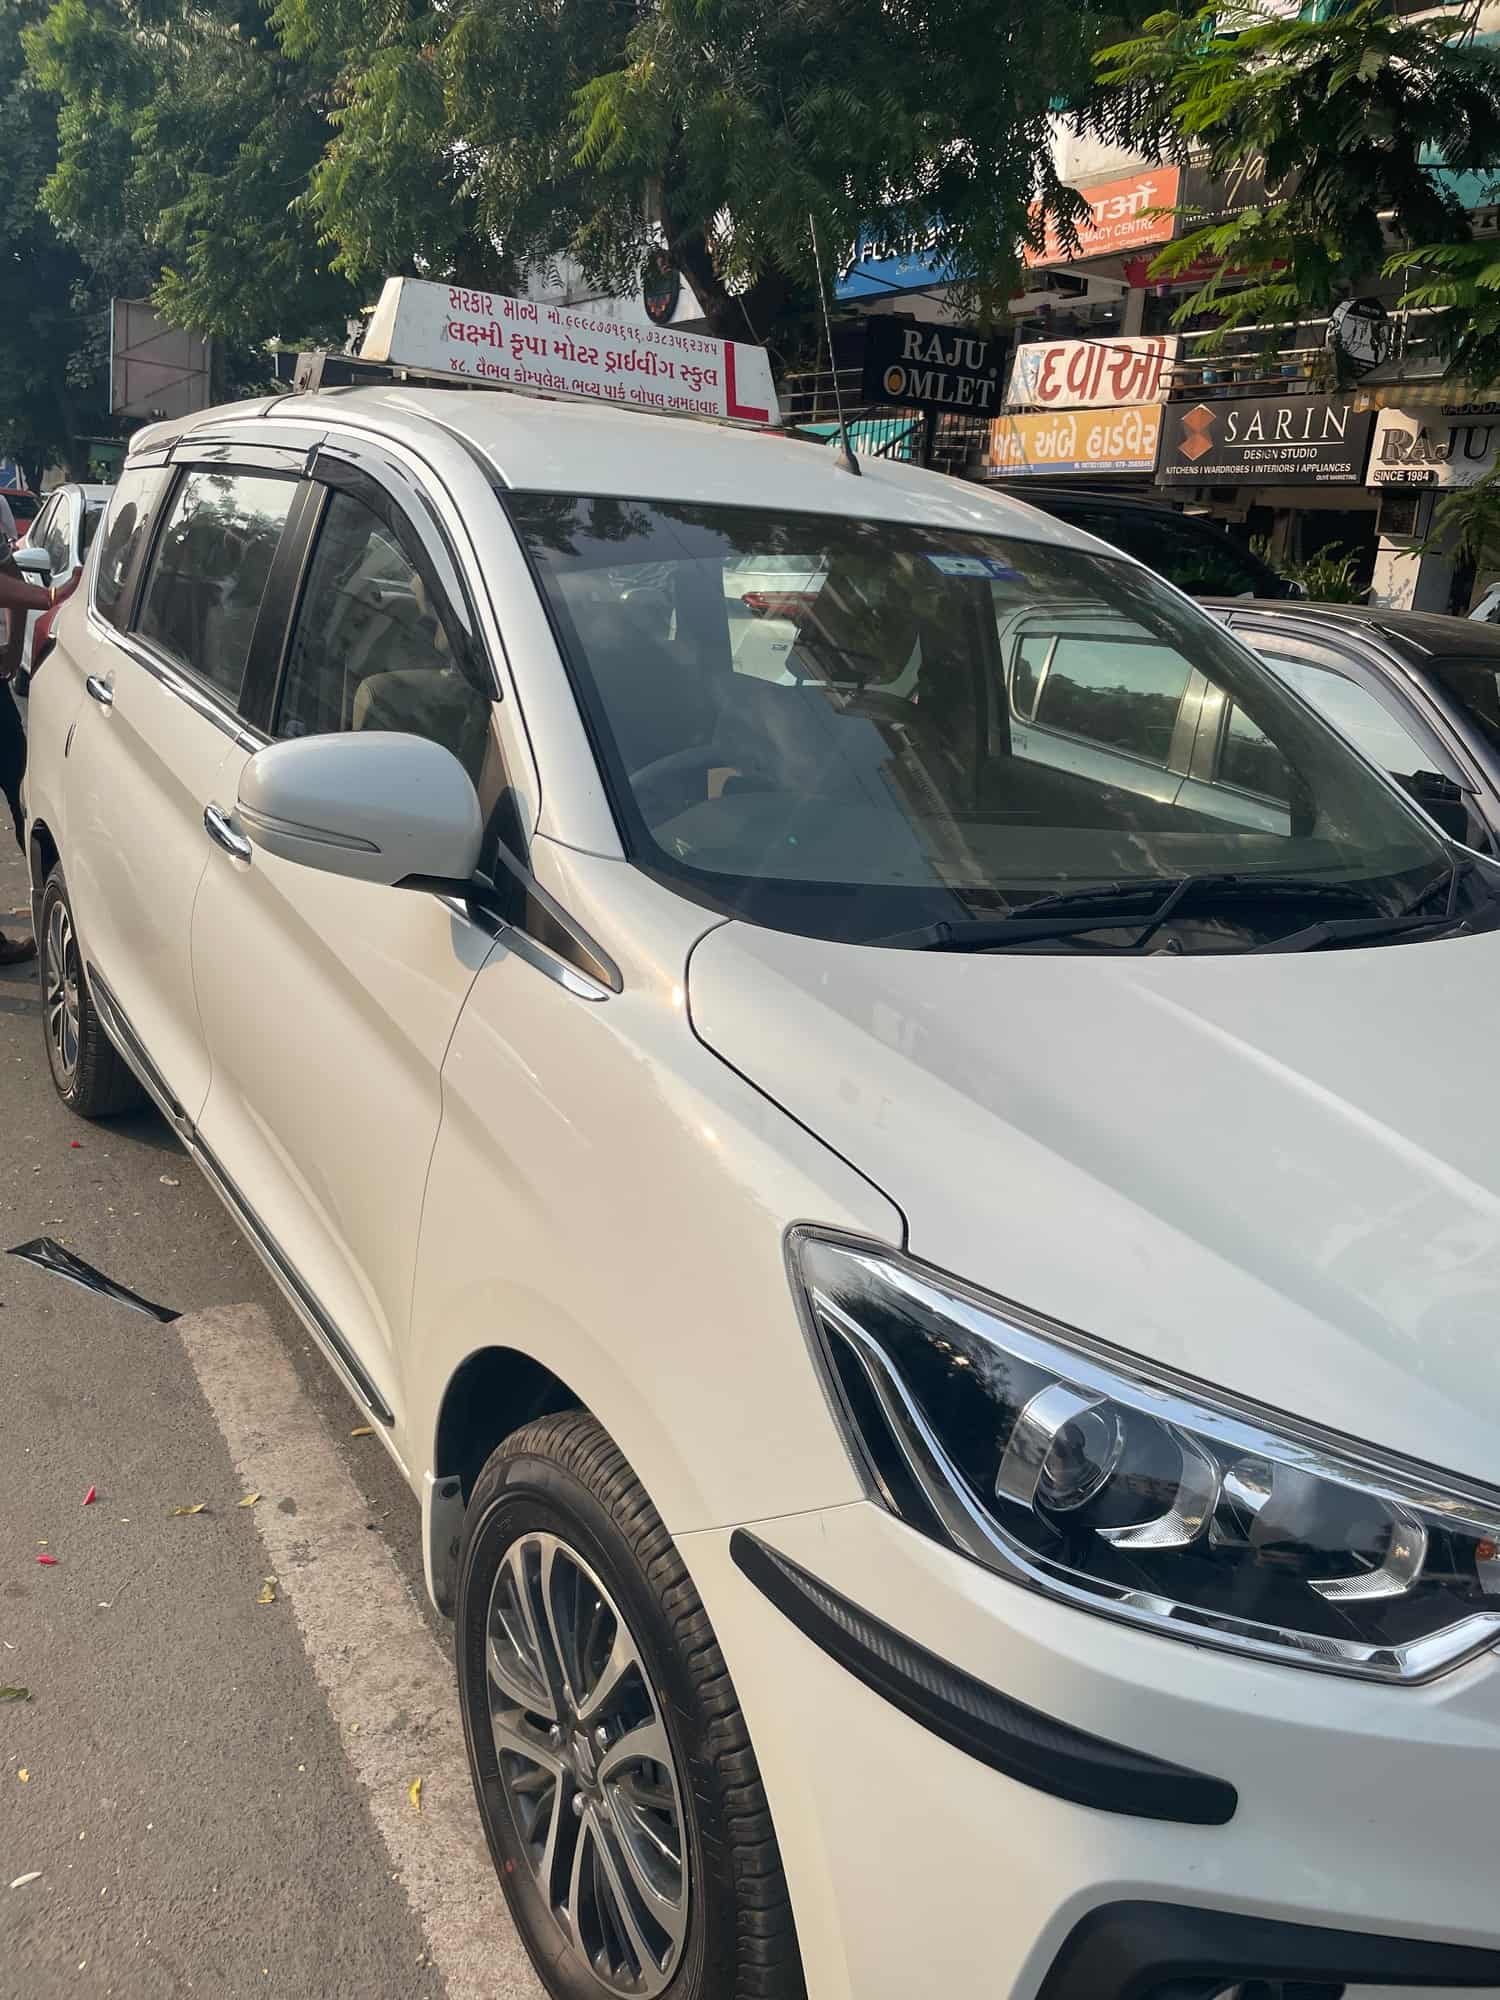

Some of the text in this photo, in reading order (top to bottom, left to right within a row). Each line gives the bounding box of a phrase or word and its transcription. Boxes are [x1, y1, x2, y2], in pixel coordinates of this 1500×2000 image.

[448, 287, 494, 316] સરકાર
[503, 298, 539, 325] માન્ય
[448, 321, 504, 348] લક્ષ્મી
[510, 333, 548, 360] કૃપા
[553, 334, 599, 366] મોટર
[901, 329, 988, 370] RAJU
[476, 356, 510, 380] વૈભવ
[571, 379, 601, 396] ભવ્ય
[604, 381, 626, 399] પાર્ક
[630, 385, 664, 406] બોપલ
[667, 395, 720, 415] અમદાવાદ
[724, 341, 769, 423] L
[883, 365, 996, 408] OMLET
[1037, 336, 1167, 401] દવાઓ
[1224, 405, 1351, 442] SARIN
[1243, 448, 1318, 461] DESIGN STUDIO
[1376, 425, 1495, 463] RAJU
[1166, 465, 1200, 475] KITCHENS
[1204, 465, 1250, 475] WARDROBES
[1255, 463, 1295, 473] INTERIORS
[1301, 463, 1351, 473] APPLIANCES
[1373, 470, 1429, 481] SINCE 1984
